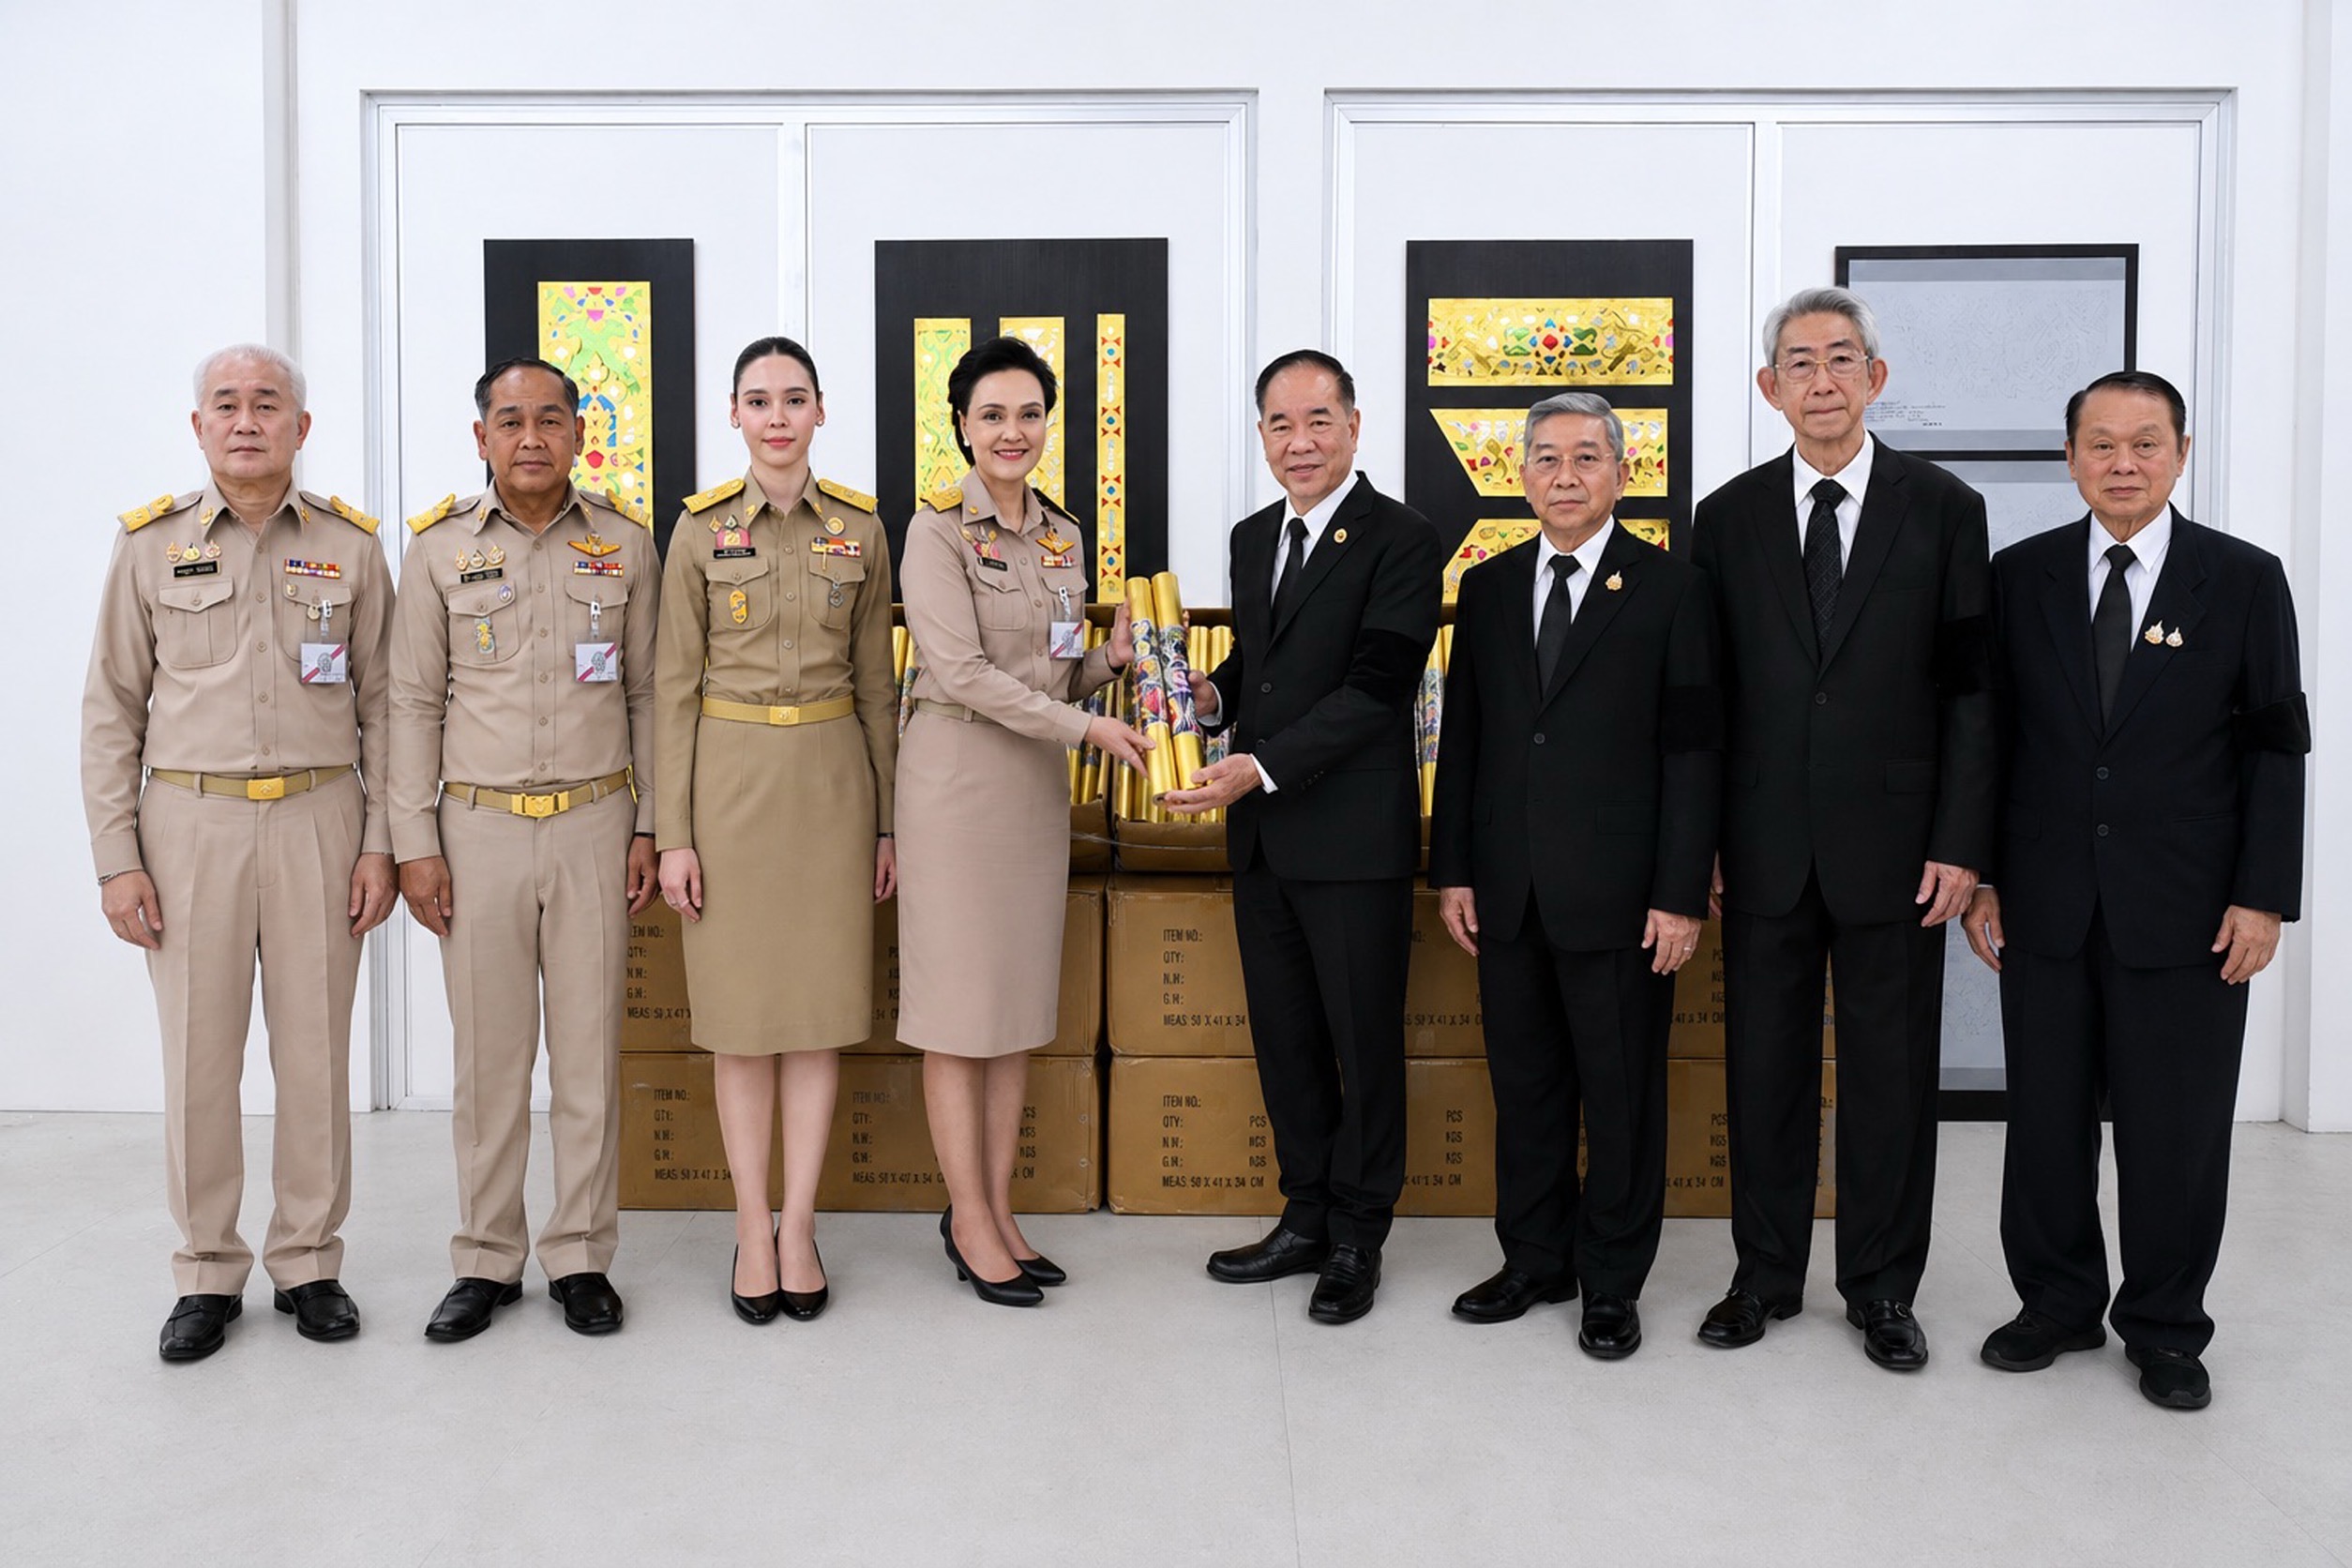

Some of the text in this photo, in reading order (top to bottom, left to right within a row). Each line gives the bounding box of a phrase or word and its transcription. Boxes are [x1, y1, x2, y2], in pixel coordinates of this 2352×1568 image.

[1164, 951, 1184, 963] QTY:
[1163, 1115, 1267, 1128] QTY: PCS
[1446, 1109, 1463, 1123] PCS
[1204, 1177, 1211, 1187] X
[1213, 1177, 1223, 1187] 41
[1225, 1177, 1231, 1187] X
[1235, 1177, 1245, 1187] 34
[1250, 1176, 1264, 1187] CM
